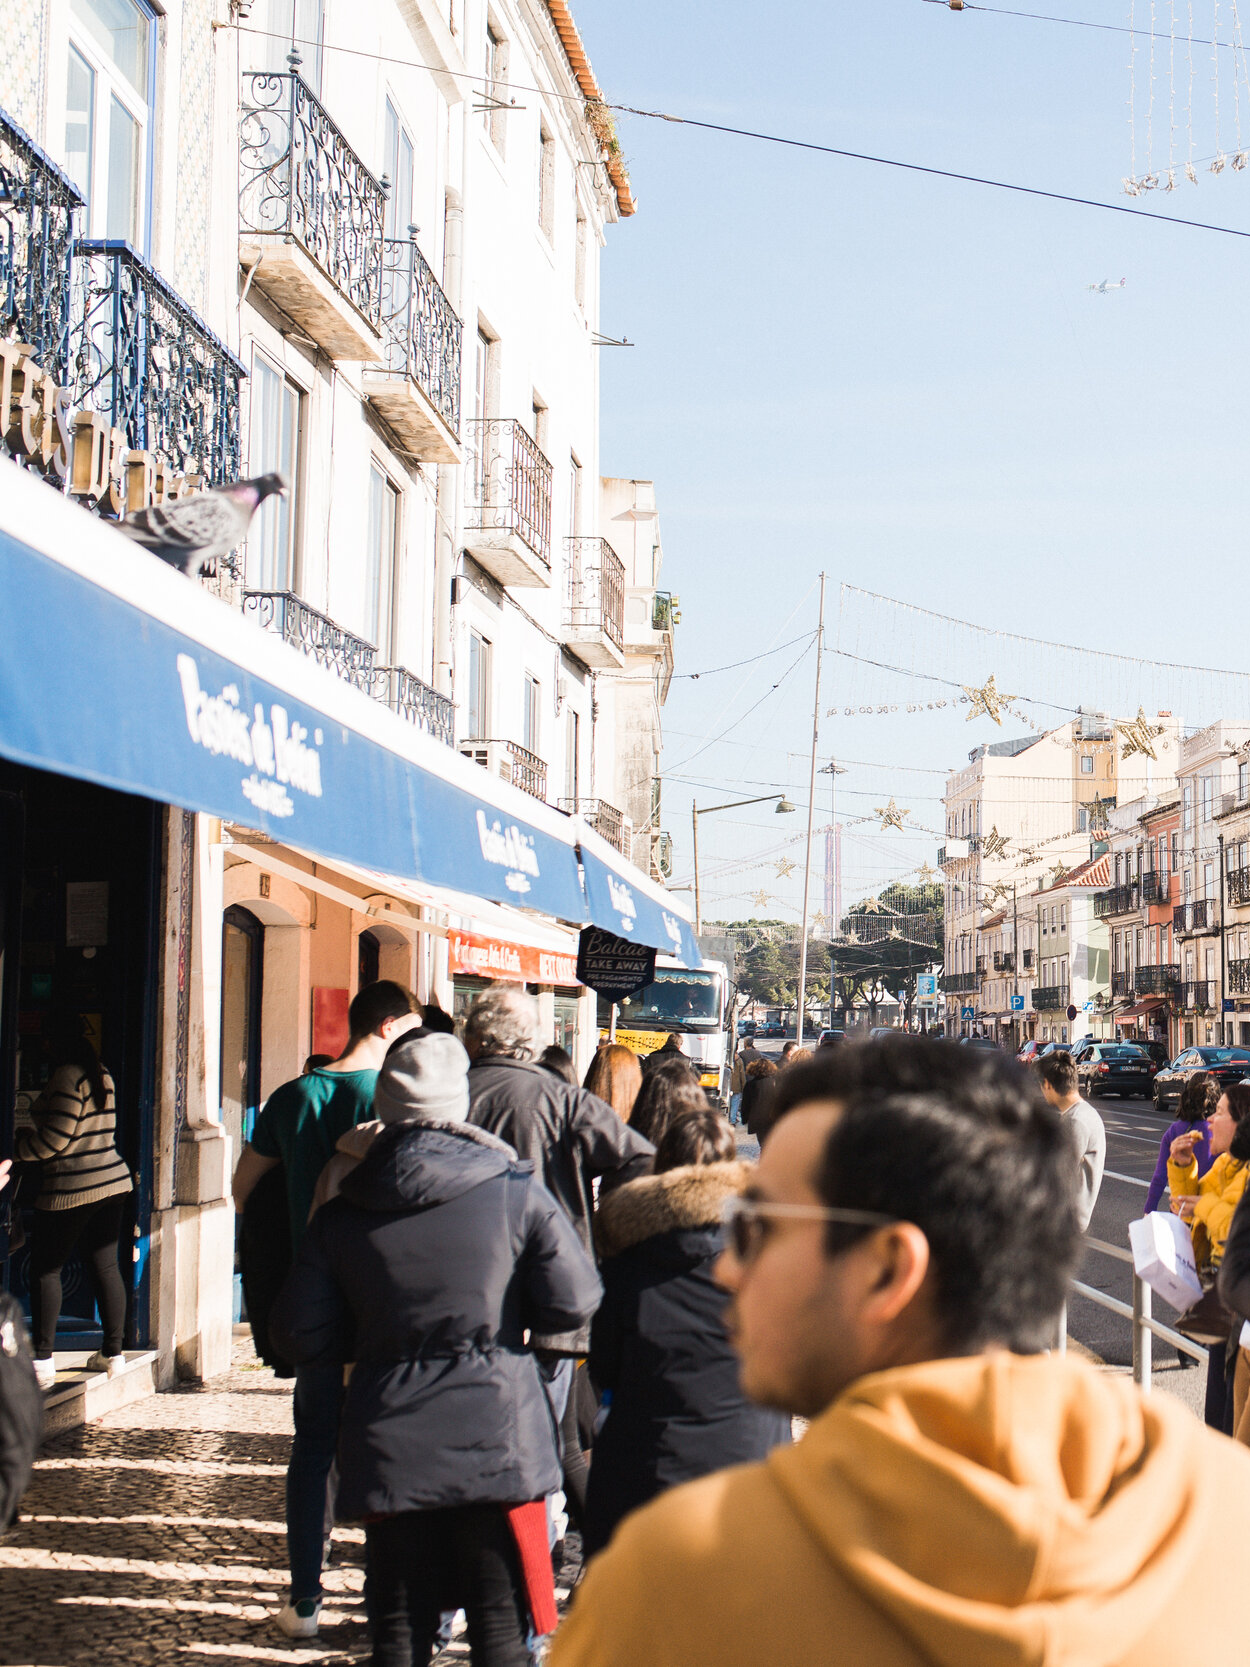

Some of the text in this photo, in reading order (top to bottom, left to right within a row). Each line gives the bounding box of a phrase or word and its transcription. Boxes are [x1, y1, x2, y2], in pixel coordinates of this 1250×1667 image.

[585, 959, 612, 970] TAKE
[616, 960, 648, 971] AWAY
[1013, 998, 1021, 1008] P
